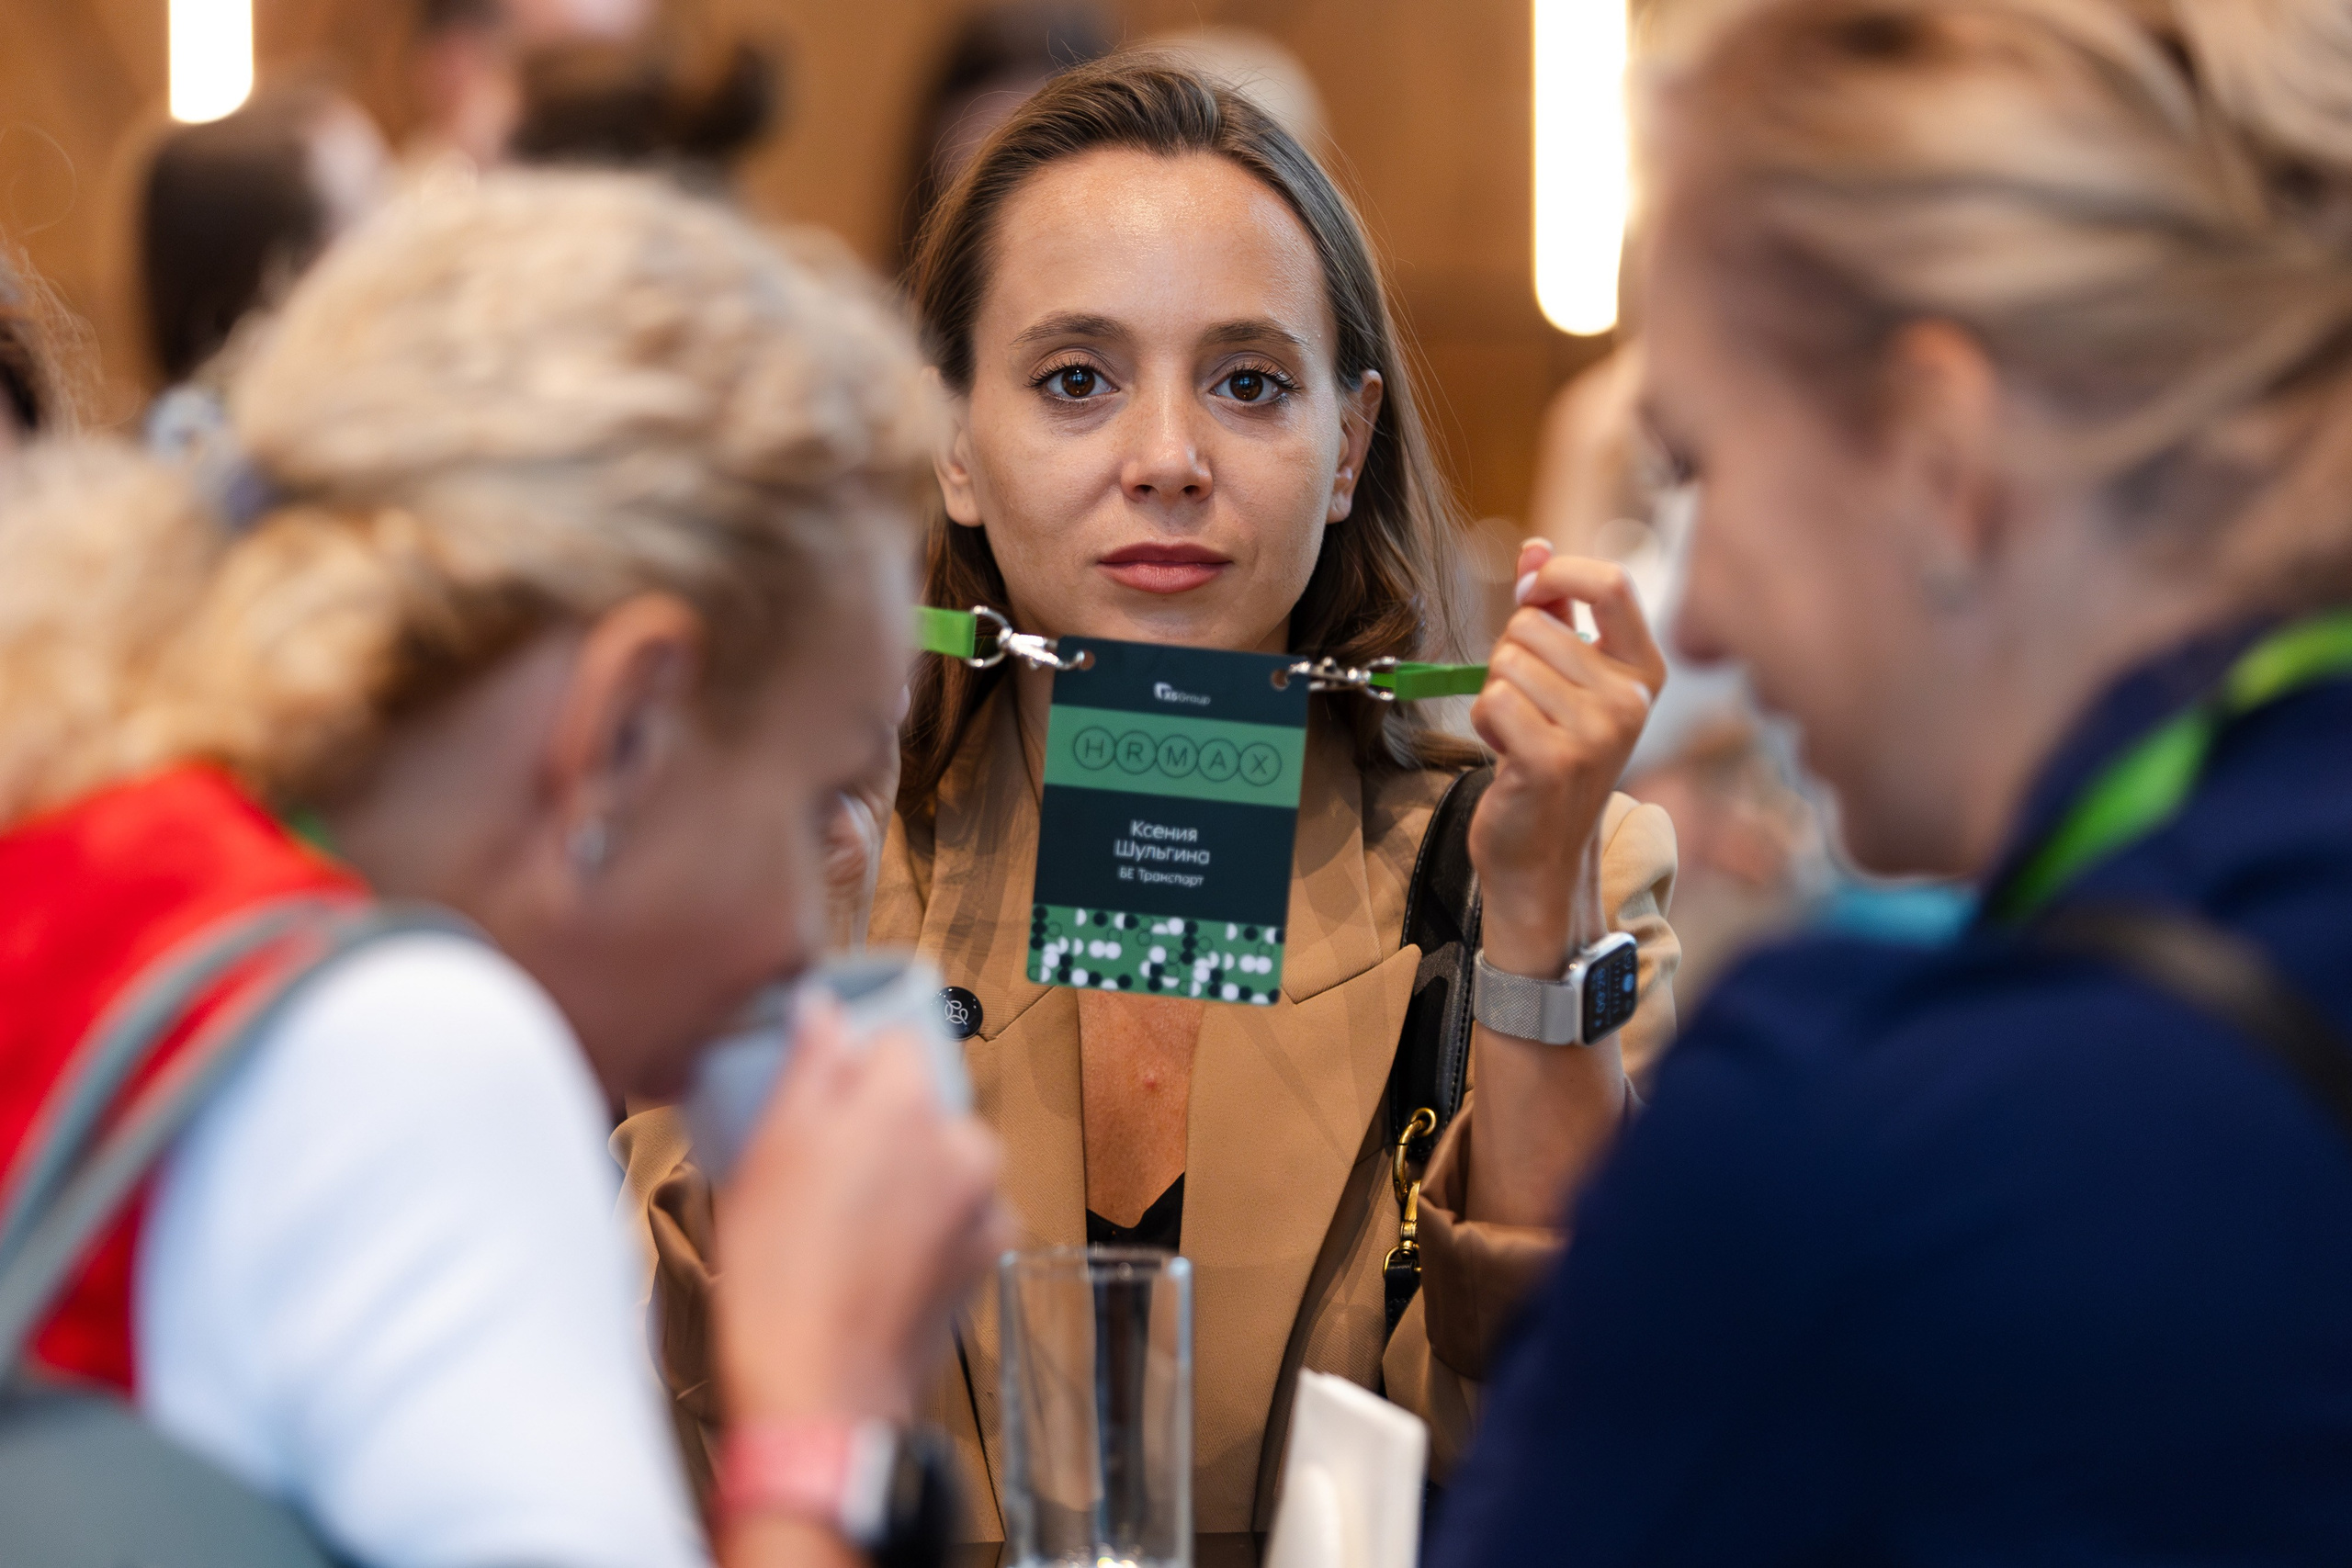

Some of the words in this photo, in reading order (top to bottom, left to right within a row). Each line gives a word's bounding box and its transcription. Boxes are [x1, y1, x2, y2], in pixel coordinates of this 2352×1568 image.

[1083, 737, 1270, 776] HRMAX
[1131, 819, 1198, 842] Ксения
[1114, 840, 1211, 864] Шульгина
[1119, 865, 1135, 880] БЕ
[1138, 868, 1204, 887] Транспорт
